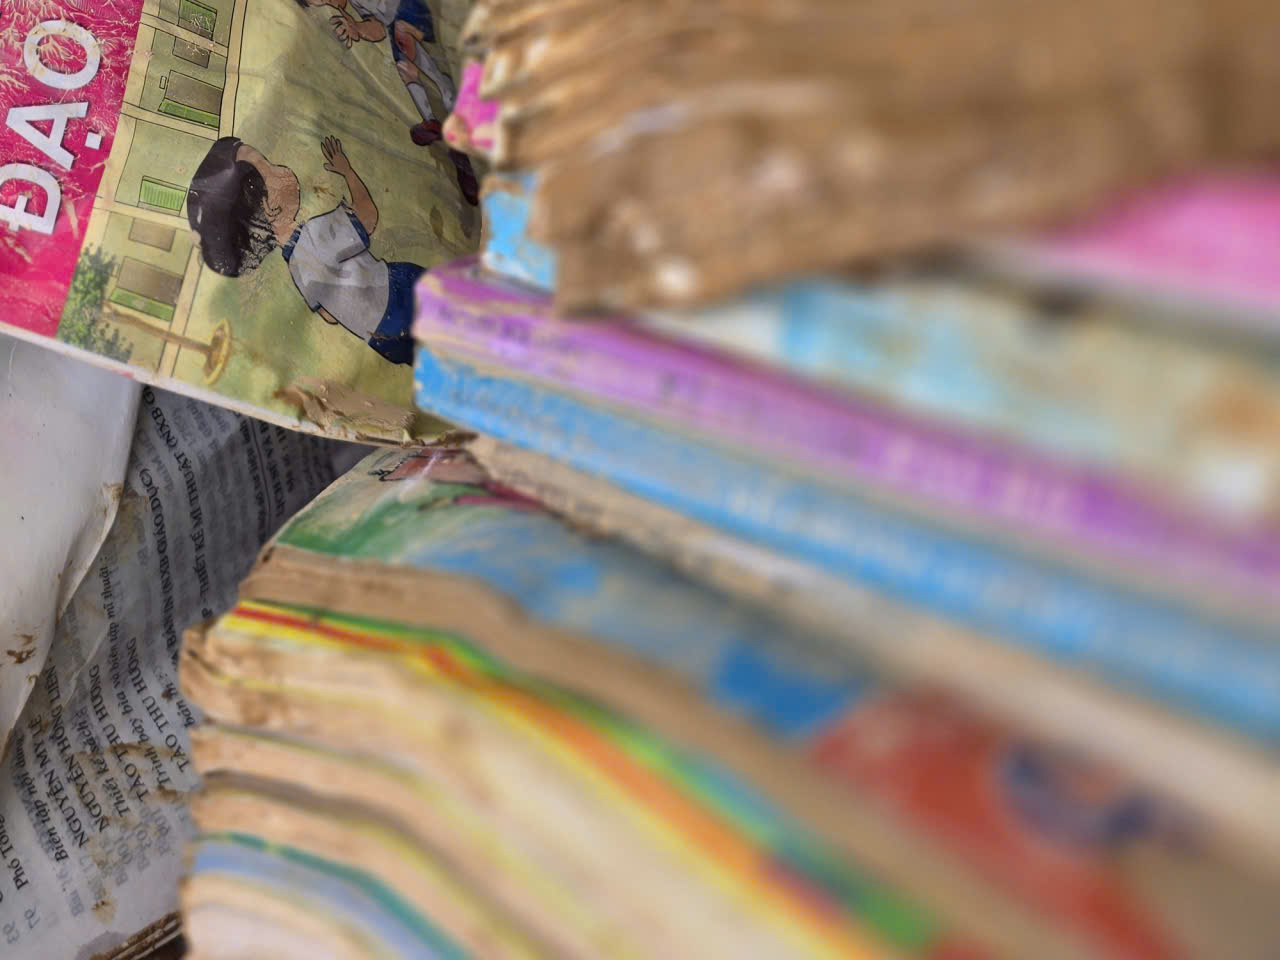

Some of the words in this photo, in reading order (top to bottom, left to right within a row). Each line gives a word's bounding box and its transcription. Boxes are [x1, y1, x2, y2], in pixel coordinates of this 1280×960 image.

[152, 407, 178, 448] (NXB
[139, 468, 162, 512] DỤC)
[89, 664, 110, 722] HƯƠNG
[48, 706, 72, 754] HỒNG
[130, 718, 150, 744] bày
[142, 696, 169, 733] THU
[102, 723, 129, 762] THU
[165, 734, 190, 773] TÀO
[65, 753, 110, 833] NGUYỄN
[124, 763, 149, 803] TÀO
[44, 769, 89, 848] NGUYỄN
[7, 857, 29, 890] Phó
